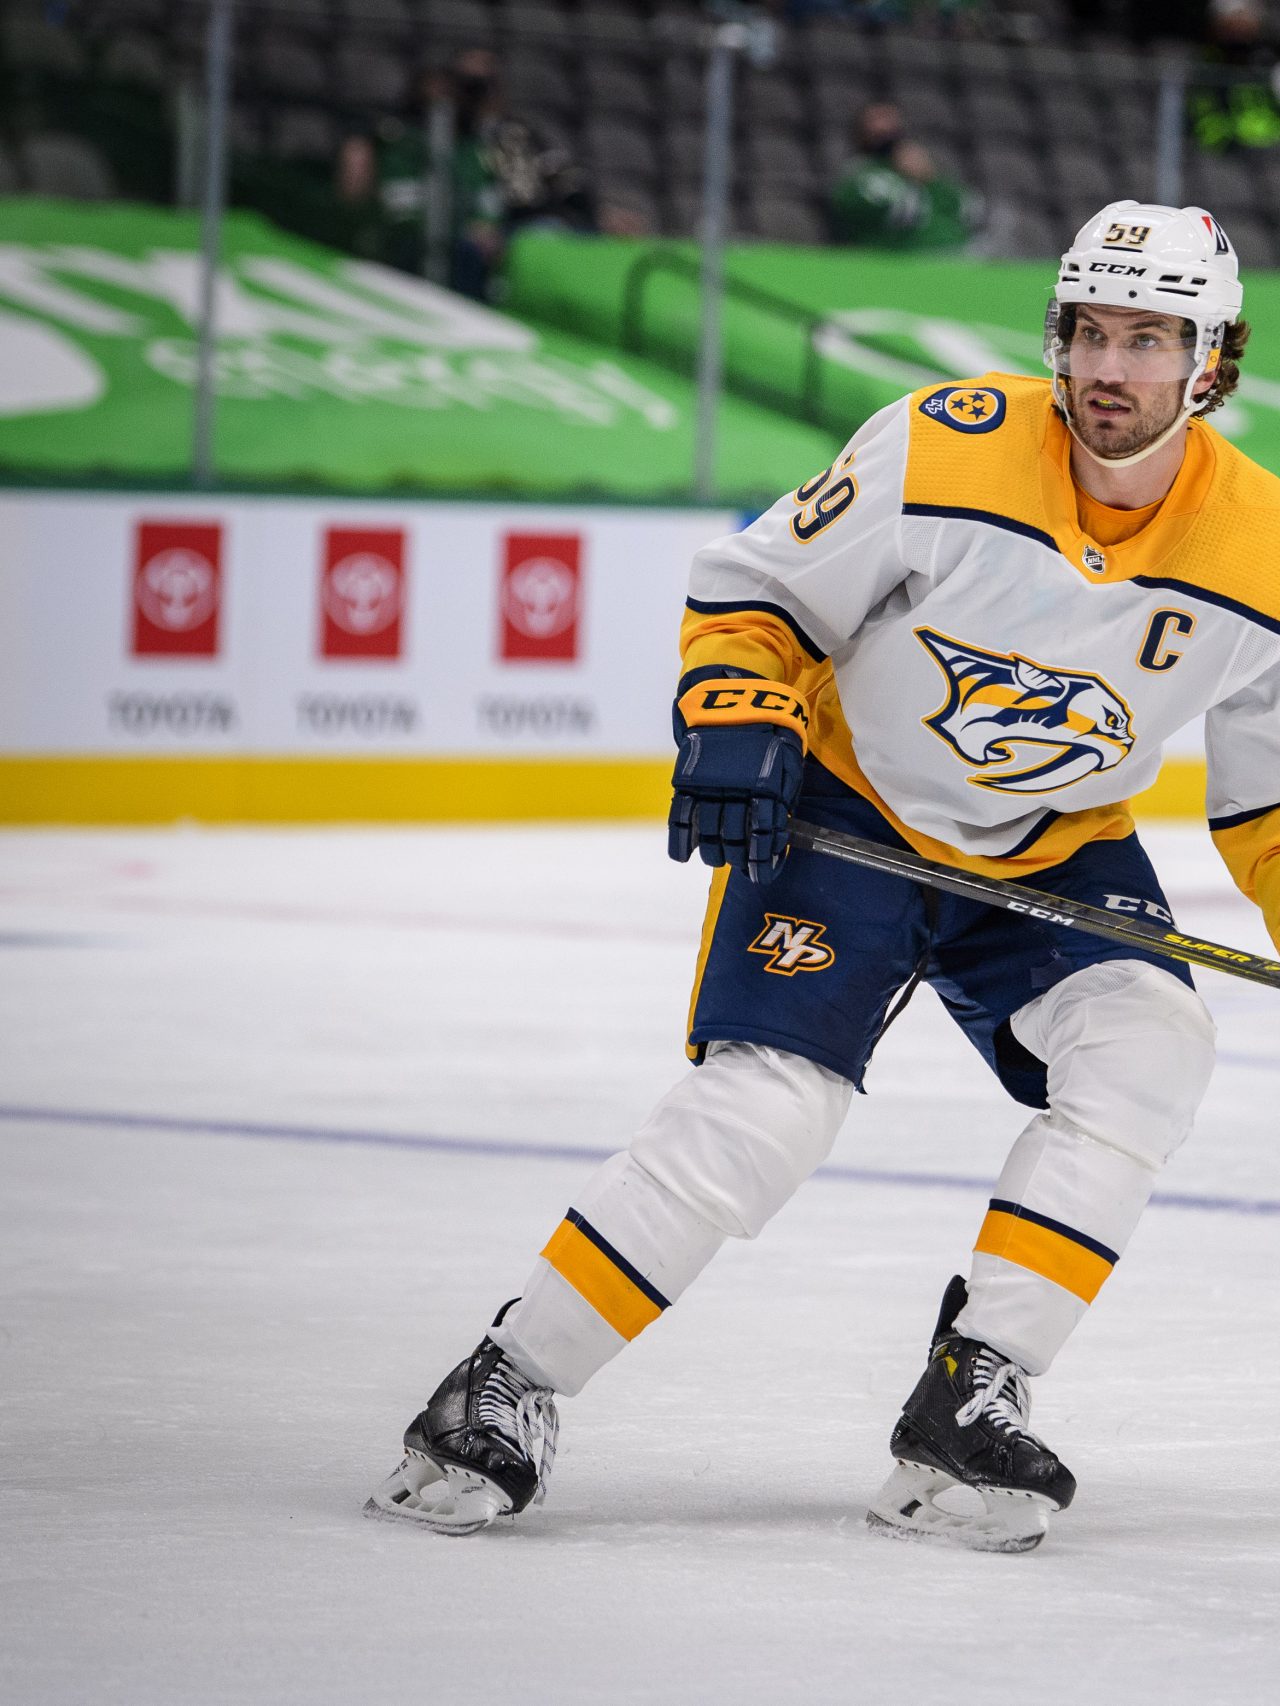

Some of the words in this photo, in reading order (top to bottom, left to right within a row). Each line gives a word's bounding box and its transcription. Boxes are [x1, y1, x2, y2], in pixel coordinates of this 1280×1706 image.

[1105, 222, 1152, 247] 59
[1089, 262, 1147, 277] CCM
[1136, 606, 1198, 674] C
[701, 689, 810, 730] CCM
[1006, 900, 1075, 927] CCM
[1103, 894, 1180, 934] CC
[747, 913, 835, 977] NP
[1163, 933, 1252, 963] SUPER
